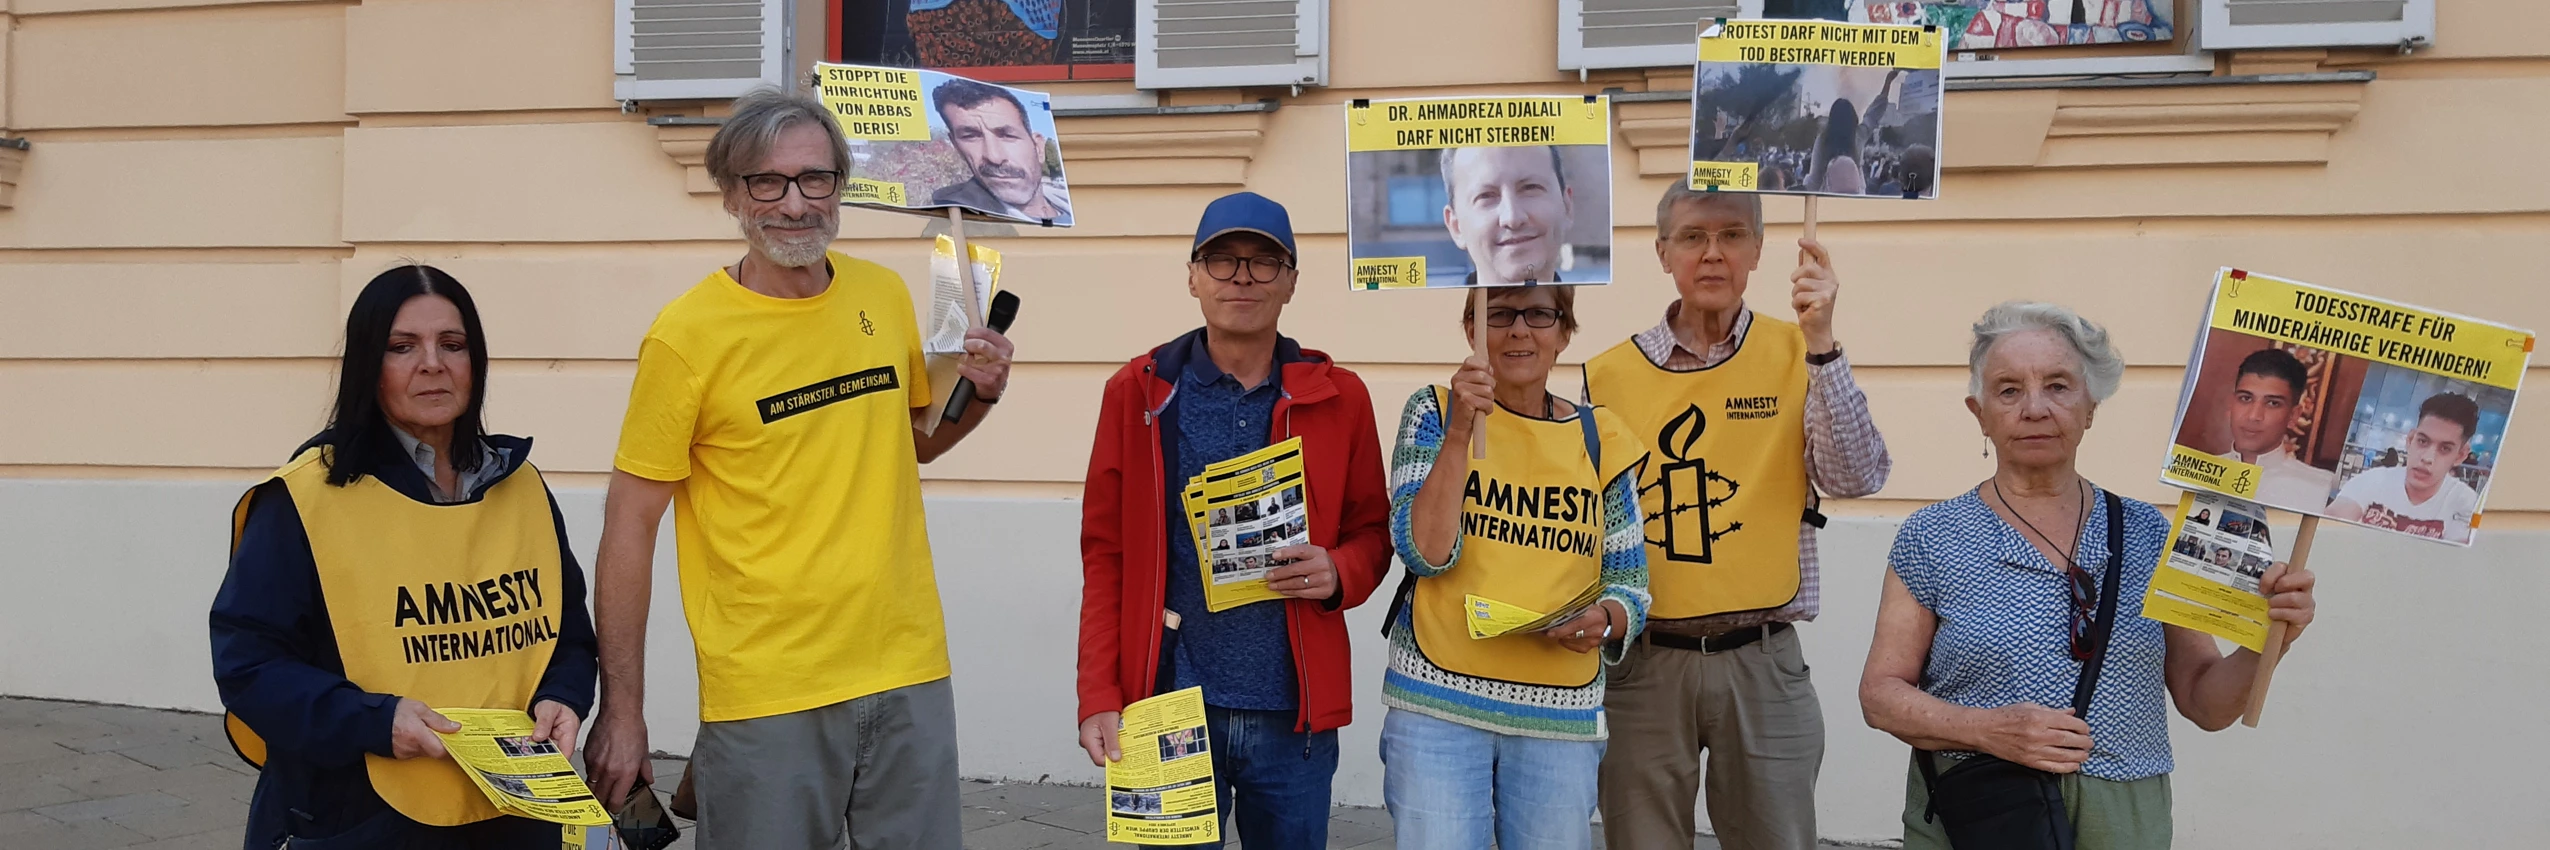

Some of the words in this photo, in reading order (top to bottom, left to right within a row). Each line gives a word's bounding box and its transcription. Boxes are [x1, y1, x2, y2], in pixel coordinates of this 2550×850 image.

[1780, 25, 1816, 40] DARF
[1820, 26, 1857, 43] NICHT
[1862, 28, 1886, 44] MIT
[1891, 29, 1920, 45] DEM
[1740, 47, 1766, 62] TOD
[1769, 48, 1837, 64] BESTRAFT
[1840, 50, 1895, 66] WERDEN
[829, 69, 880, 82] STOPPT
[885, 72, 908, 84] DIE
[825, 85, 918, 101] HINRICHTUNG
[836, 102, 863, 116] VON
[868, 104, 912, 117] ABBAS
[1388, 105, 1413, 122] DR.
[1418, 103, 1503, 121] AHMADREZA
[1508, 101, 1562, 118] DJALALI
[853, 122, 900, 135] DERIS!
[1397, 129, 1434, 146] DARF
[1439, 128, 1482, 145] NICHT
[1487, 125, 1555, 143] STERBEN!
[1693, 167, 1732, 178] AMNESTY
[1356, 264, 1398, 276] AMNESTY
[2294, 290, 2416, 333] TODESSTRAFE
[2418, 316, 2456, 342] FÜR
[2232, 308, 2373, 355] MINDERJÄHRIGE
[2378, 337, 2492, 380] VERHINDERN!
[770, 401, 785, 416] AM
[787, 385, 837, 410] STÄRKSTEN.
[840, 373, 892, 395] GEMEINSAM.
[1725, 395, 1778, 410] AMNESTY
[1726, 408, 1779, 420] INTERNATIONAL
[2173, 453, 2227, 477] AMNESTY
[2170, 466, 2221, 486] INTERNATIONAL
[1462, 470, 1598, 527] AMNESTY
[395, 568, 542, 627] AMNESTY
[402, 615, 558, 664] INTERNATIONAL
